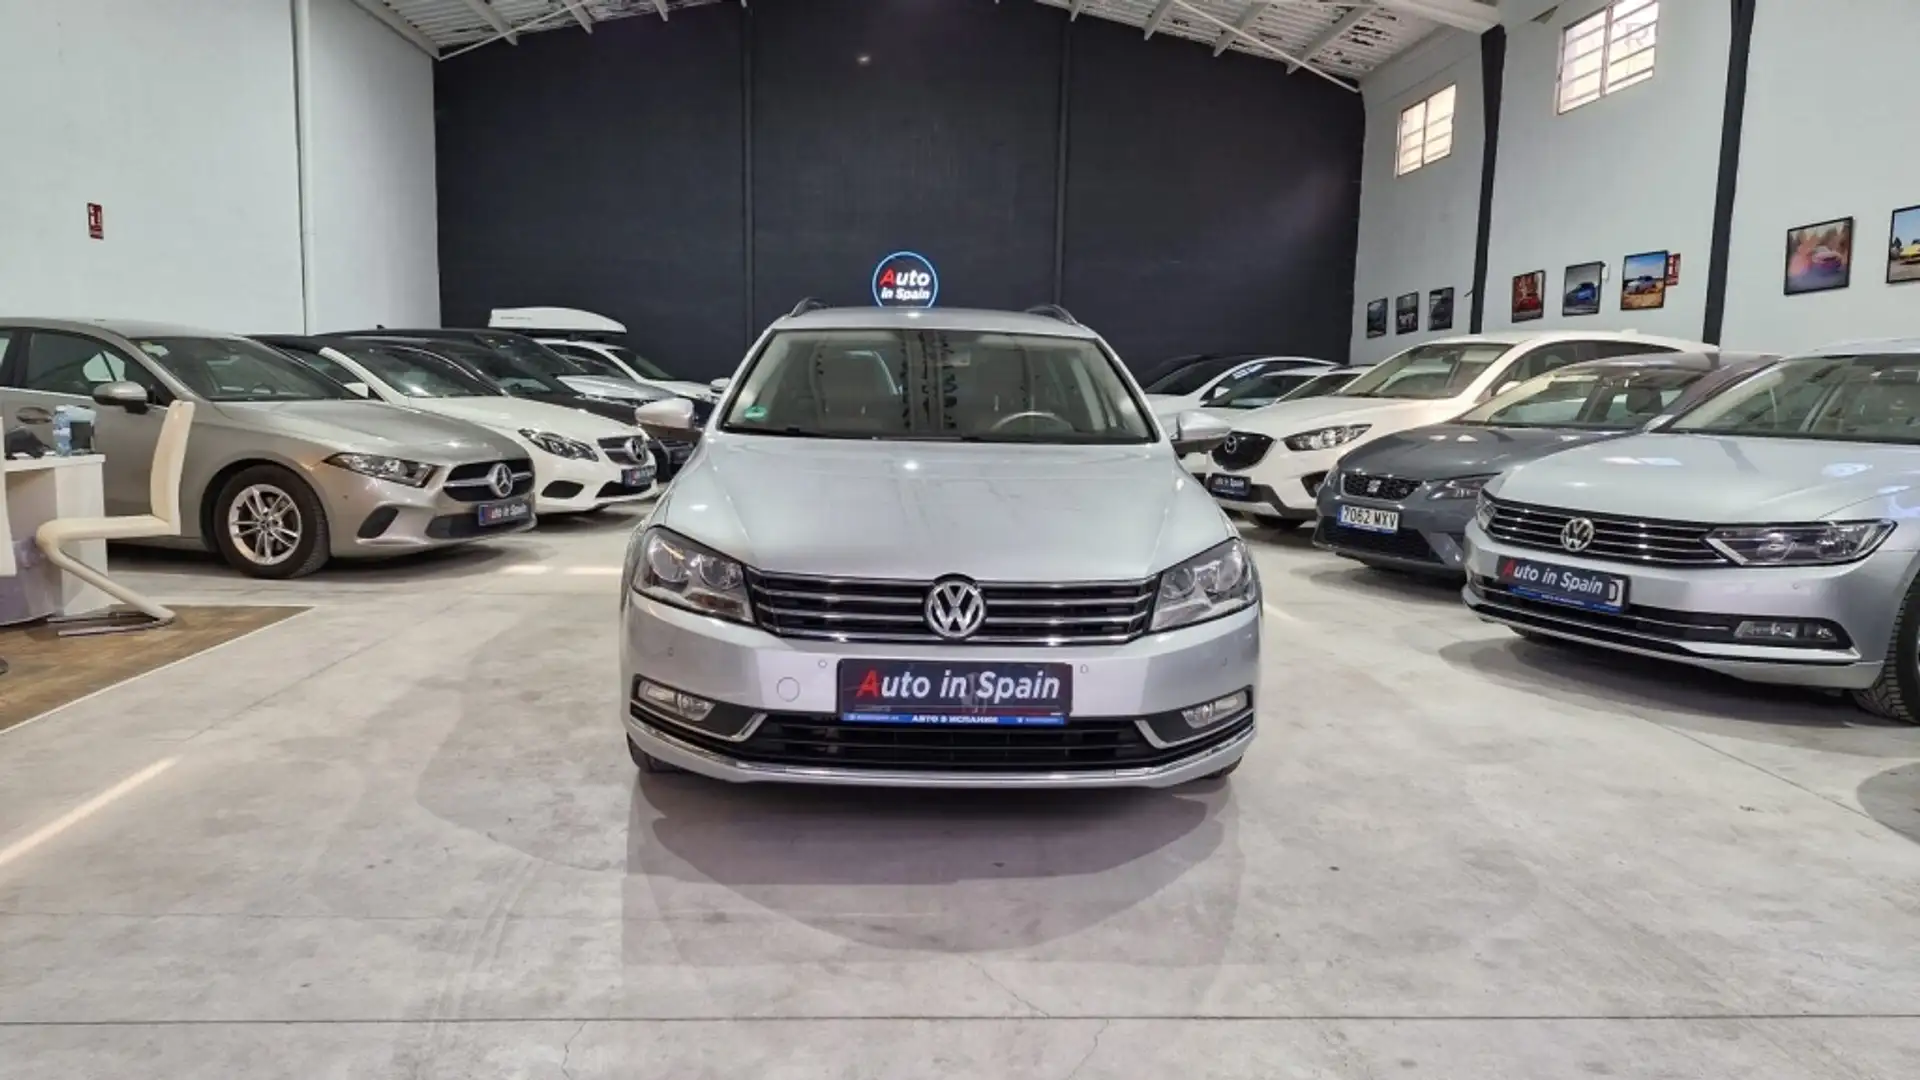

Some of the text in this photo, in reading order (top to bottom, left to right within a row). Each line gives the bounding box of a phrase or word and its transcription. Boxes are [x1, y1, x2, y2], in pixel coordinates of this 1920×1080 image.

[879, 267, 931, 286] Auto
[881, 287, 930, 301] in Spain
[1343, 506, 1370, 524] 7062
[1503, 560, 1539, 581] Auto
[1542, 568, 1558, 585] in
[1560, 571, 1604, 595] Spain
[857, 669, 1060, 703] Auto in Spain
